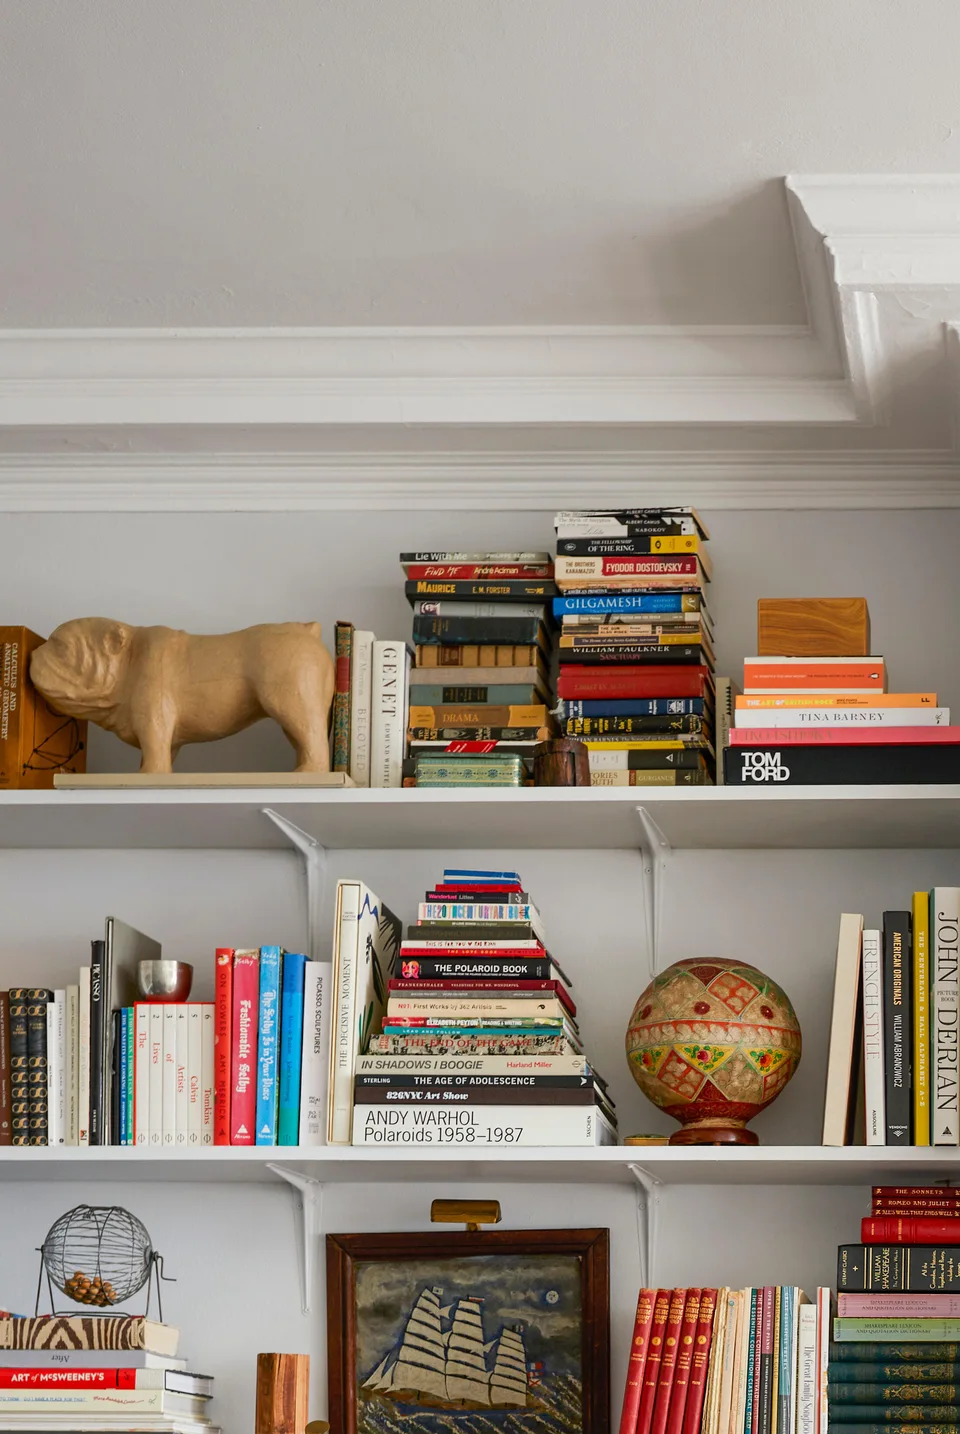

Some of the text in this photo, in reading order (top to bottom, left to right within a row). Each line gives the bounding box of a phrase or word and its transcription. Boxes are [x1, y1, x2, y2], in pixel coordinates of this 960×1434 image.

[606, 563, 682, 572] FYODOR DOSTOEVSKY
[417, 582, 456, 593] MAURICE
[565, 597, 642, 609] GILGAMESH
[382, 647, 397, 717] GENET
[443, 714, 479, 723] DRAMA
[799, 713, 885, 722] TINA BARNEY
[741, 752, 781, 767] TOM
[741, 766, 790, 781] FORD
[937, 911, 959, 984] JOHN
[434, 964, 528, 973] THE POLAROID BOOK
[893, 932, 902, 1006] AMERICAN ORIGINALS
[220, 974, 226, 988] ON
[340, 957, 351, 1069] THE DECISIVE MOMENT
[314, 1010, 322, 1054] SCULPTURES
[865, 1011, 879, 1060] STYLE
[138, 1032, 146, 1049] The
[153, 1041, 161, 1065] Lives
[937, 1009, 958, 1112] DERIAN
[361, 1060, 373, 1070] IN
[375, 1060, 431, 1070] SHADOWS
[440, 1060, 484, 1070] BOOGIE
[414, 1077, 535, 1085] THE AGE OF ADOLESCENCE
[190, 1075, 198, 1103] Calvin
[386, 1091, 469, 1100] 826NYC Art Show
[204, 1088, 212, 1125] Tomkins
[218, 1079, 226, 1121] MERRICK
[365, 1110, 480, 1125] ANDY WARHOL
[364, 1127, 433, 1142] Polaroids
[882, 1248, 890, 1289] SHAKESPEARE
[11, 1374, 30, 1382] ART
